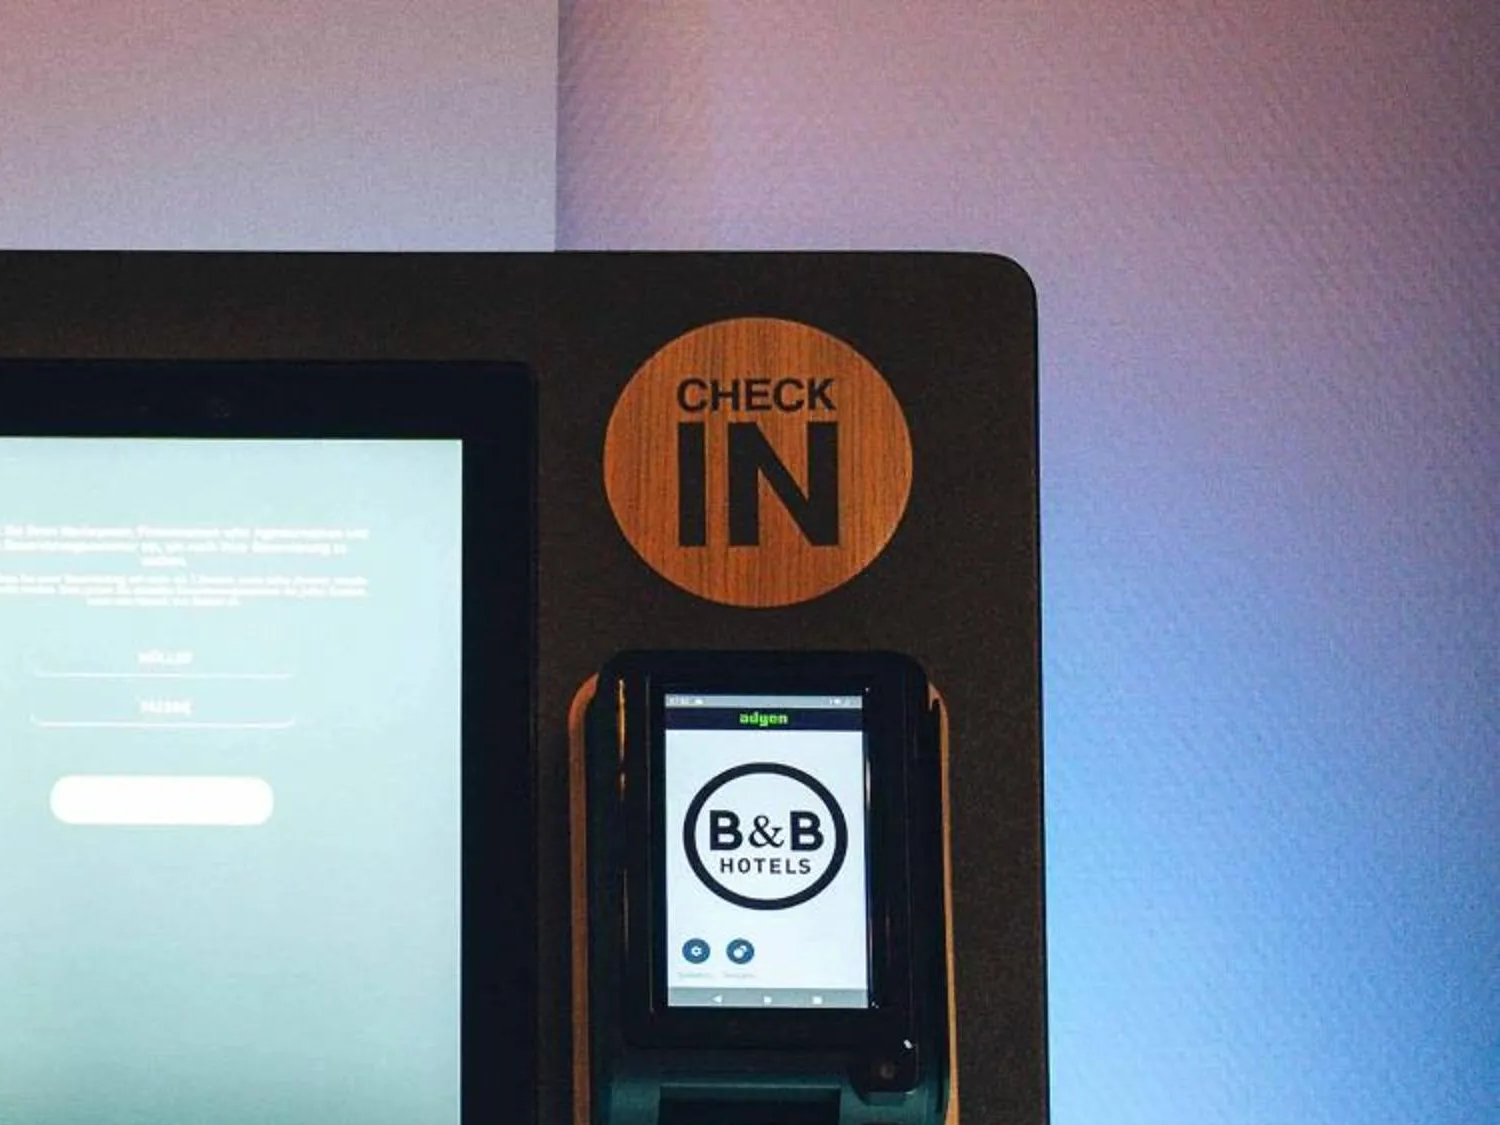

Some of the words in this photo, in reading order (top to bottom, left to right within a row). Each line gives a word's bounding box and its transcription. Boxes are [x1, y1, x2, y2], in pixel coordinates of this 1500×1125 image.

[677, 378, 836, 413] CHECK
[678, 421, 839, 548] IN
[739, 711, 789, 727] adyen
[709, 808, 825, 851] B&B
[720, 857, 812, 875] HOTELS
